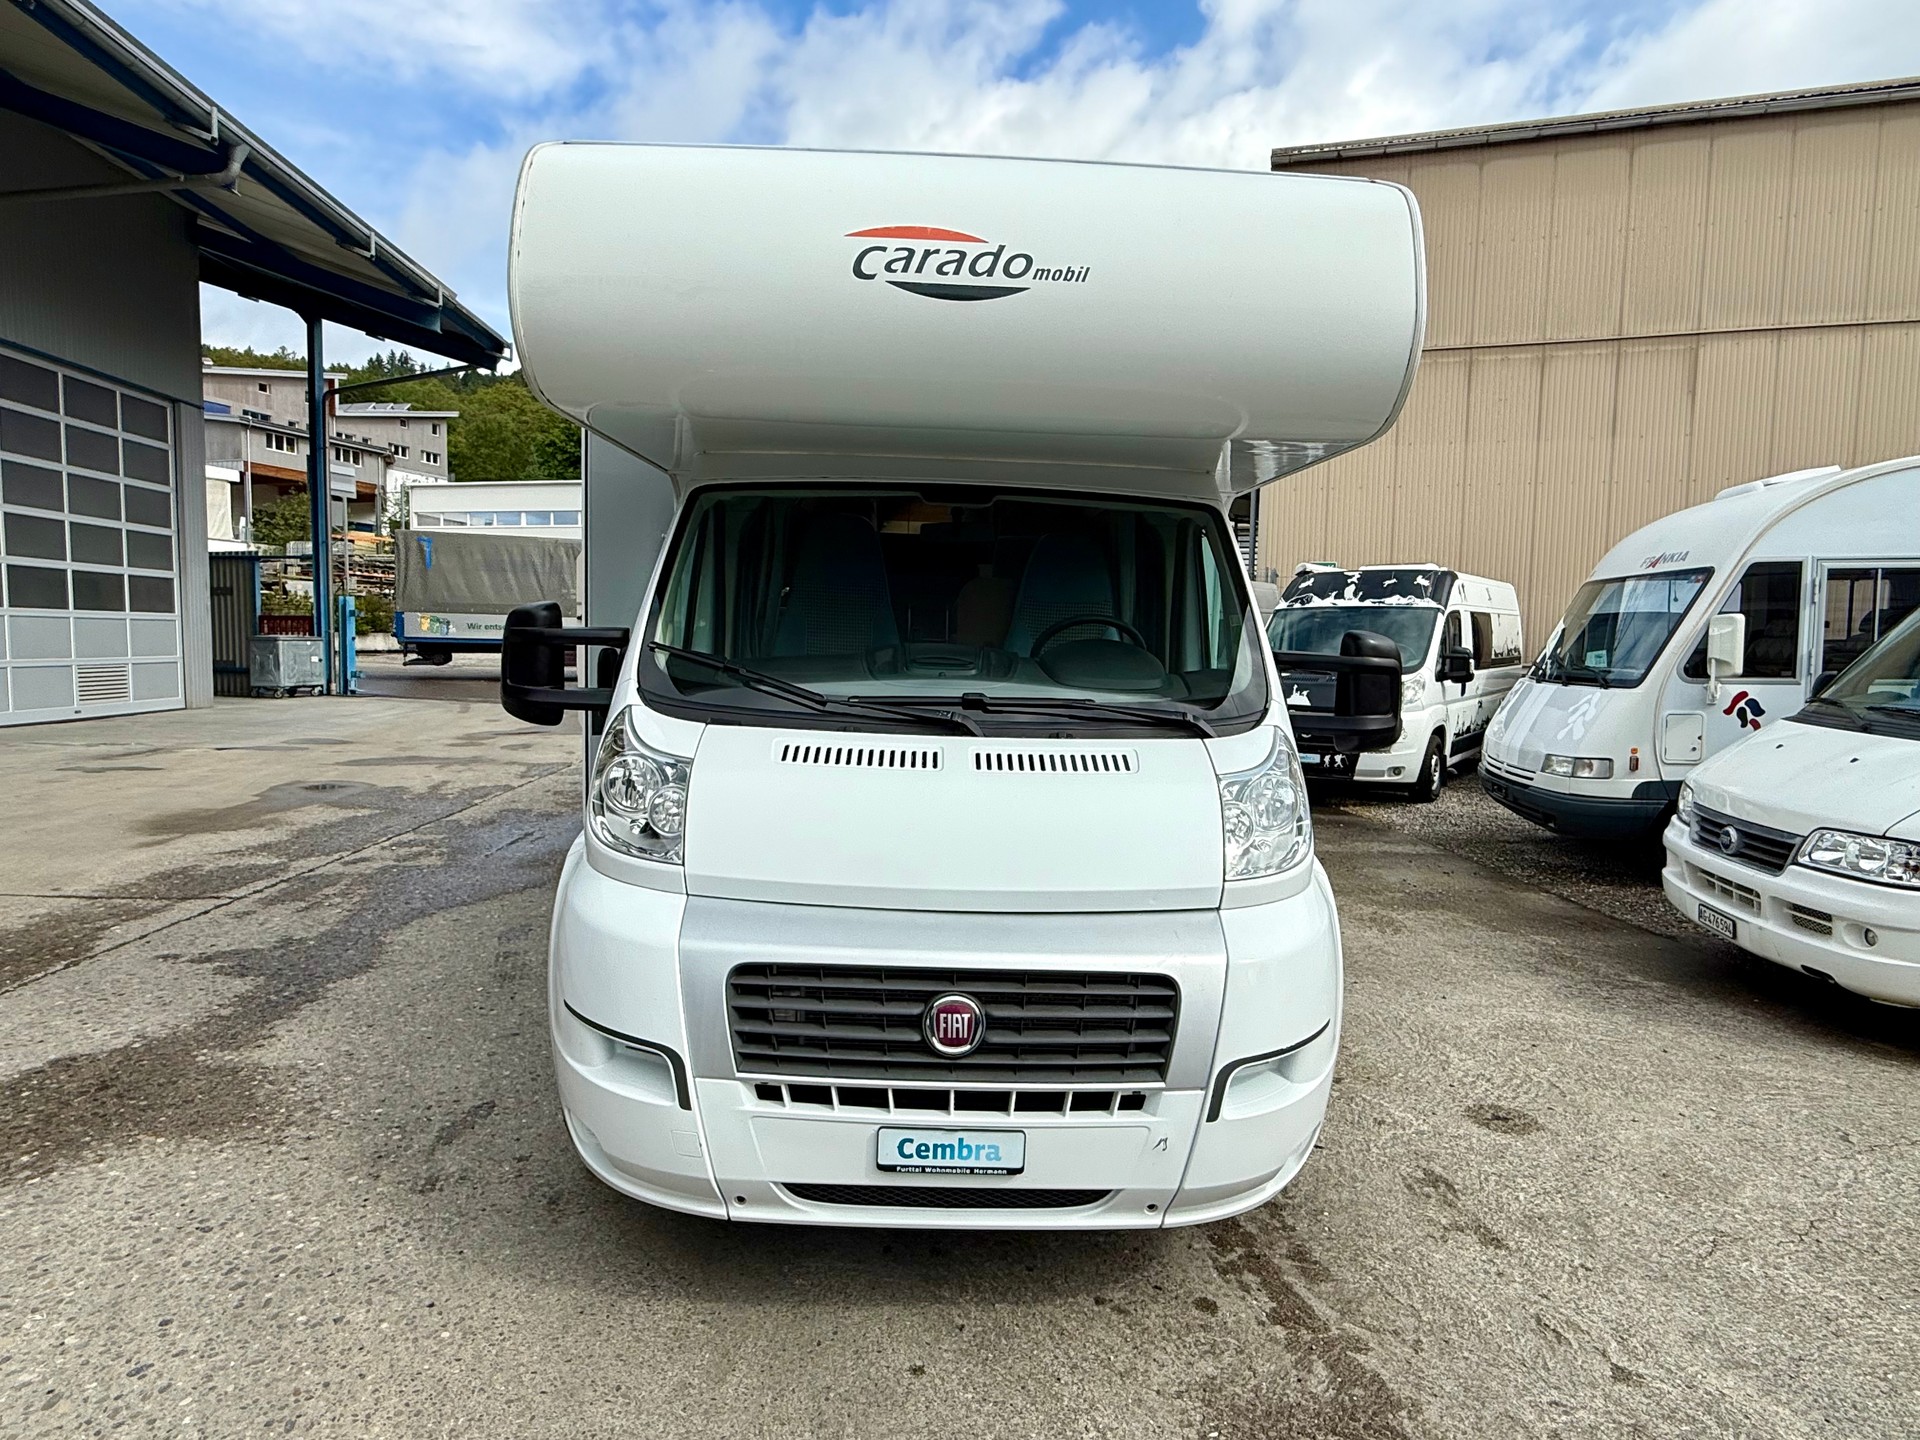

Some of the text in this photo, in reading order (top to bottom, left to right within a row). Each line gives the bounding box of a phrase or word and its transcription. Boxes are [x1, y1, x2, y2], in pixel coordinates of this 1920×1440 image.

[1032, 266, 1091, 283] mobil
[1640, 550, 1690, 569] FRANKIA
[466, 622, 506, 631] Wir ents
[939, 1013, 971, 1039] FIAT
[896, 1137, 1002, 1162] Cembra
[924, 1166, 971, 1174] Wohnmobile
